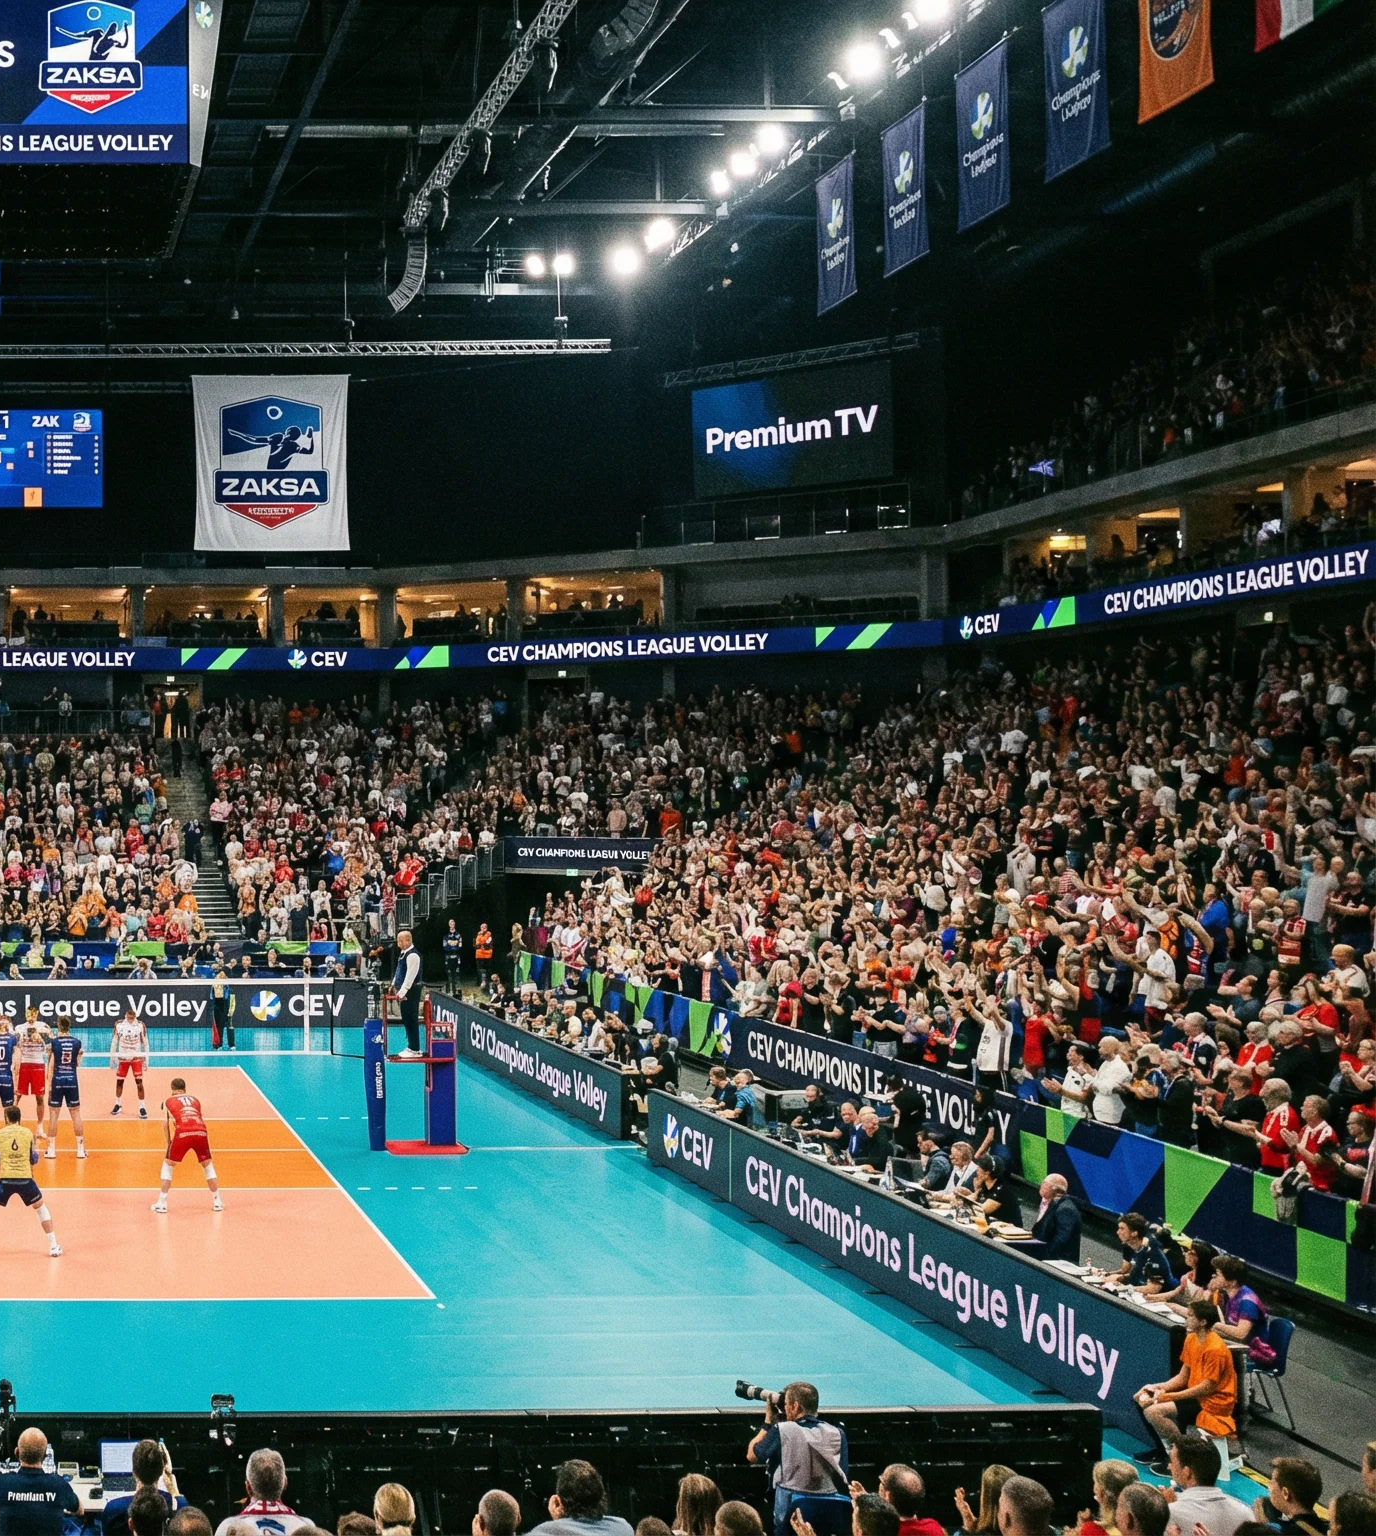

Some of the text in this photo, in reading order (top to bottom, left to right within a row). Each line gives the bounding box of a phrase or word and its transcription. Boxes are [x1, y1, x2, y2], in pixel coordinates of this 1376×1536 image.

[47, 67, 135, 84] ZAKSA
[19, 135, 94, 152] LEAGUE
[98, 134, 173, 151] VOLLEY
[32, 415, 60, 428] ZAK
[706, 404, 878, 454] Premium TV
[222, 478, 321, 496] ZAKSA
[1104, 549, 1369, 615] CEV CHAMPIONS LEAGUE VOLLEY
[974, 613, 1000, 635] CEV
[2, 652, 67, 667] LEAGUE
[71, 651, 135, 667] VOLLEY
[310, 651, 347, 667] CEV
[488, 633, 768, 662] CEV CHAMPIONS LEAGUE VOLLEY
[127, 993, 207, 1022] Volley
[288, 994, 344, 1017] CEV
[470, 1021, 485, 1051] CEV
[536, 1052, 571, 1097] League
[573, 1070, 607, 1121] Volley
[748, 1031, 773, 1063] CEV
[775, 1038, 862, 1095] CHAMPIONS
[681, 1126, 713, 1171] CEV
[745, 1156, 1119, 1400] CEV Champions League Volley
